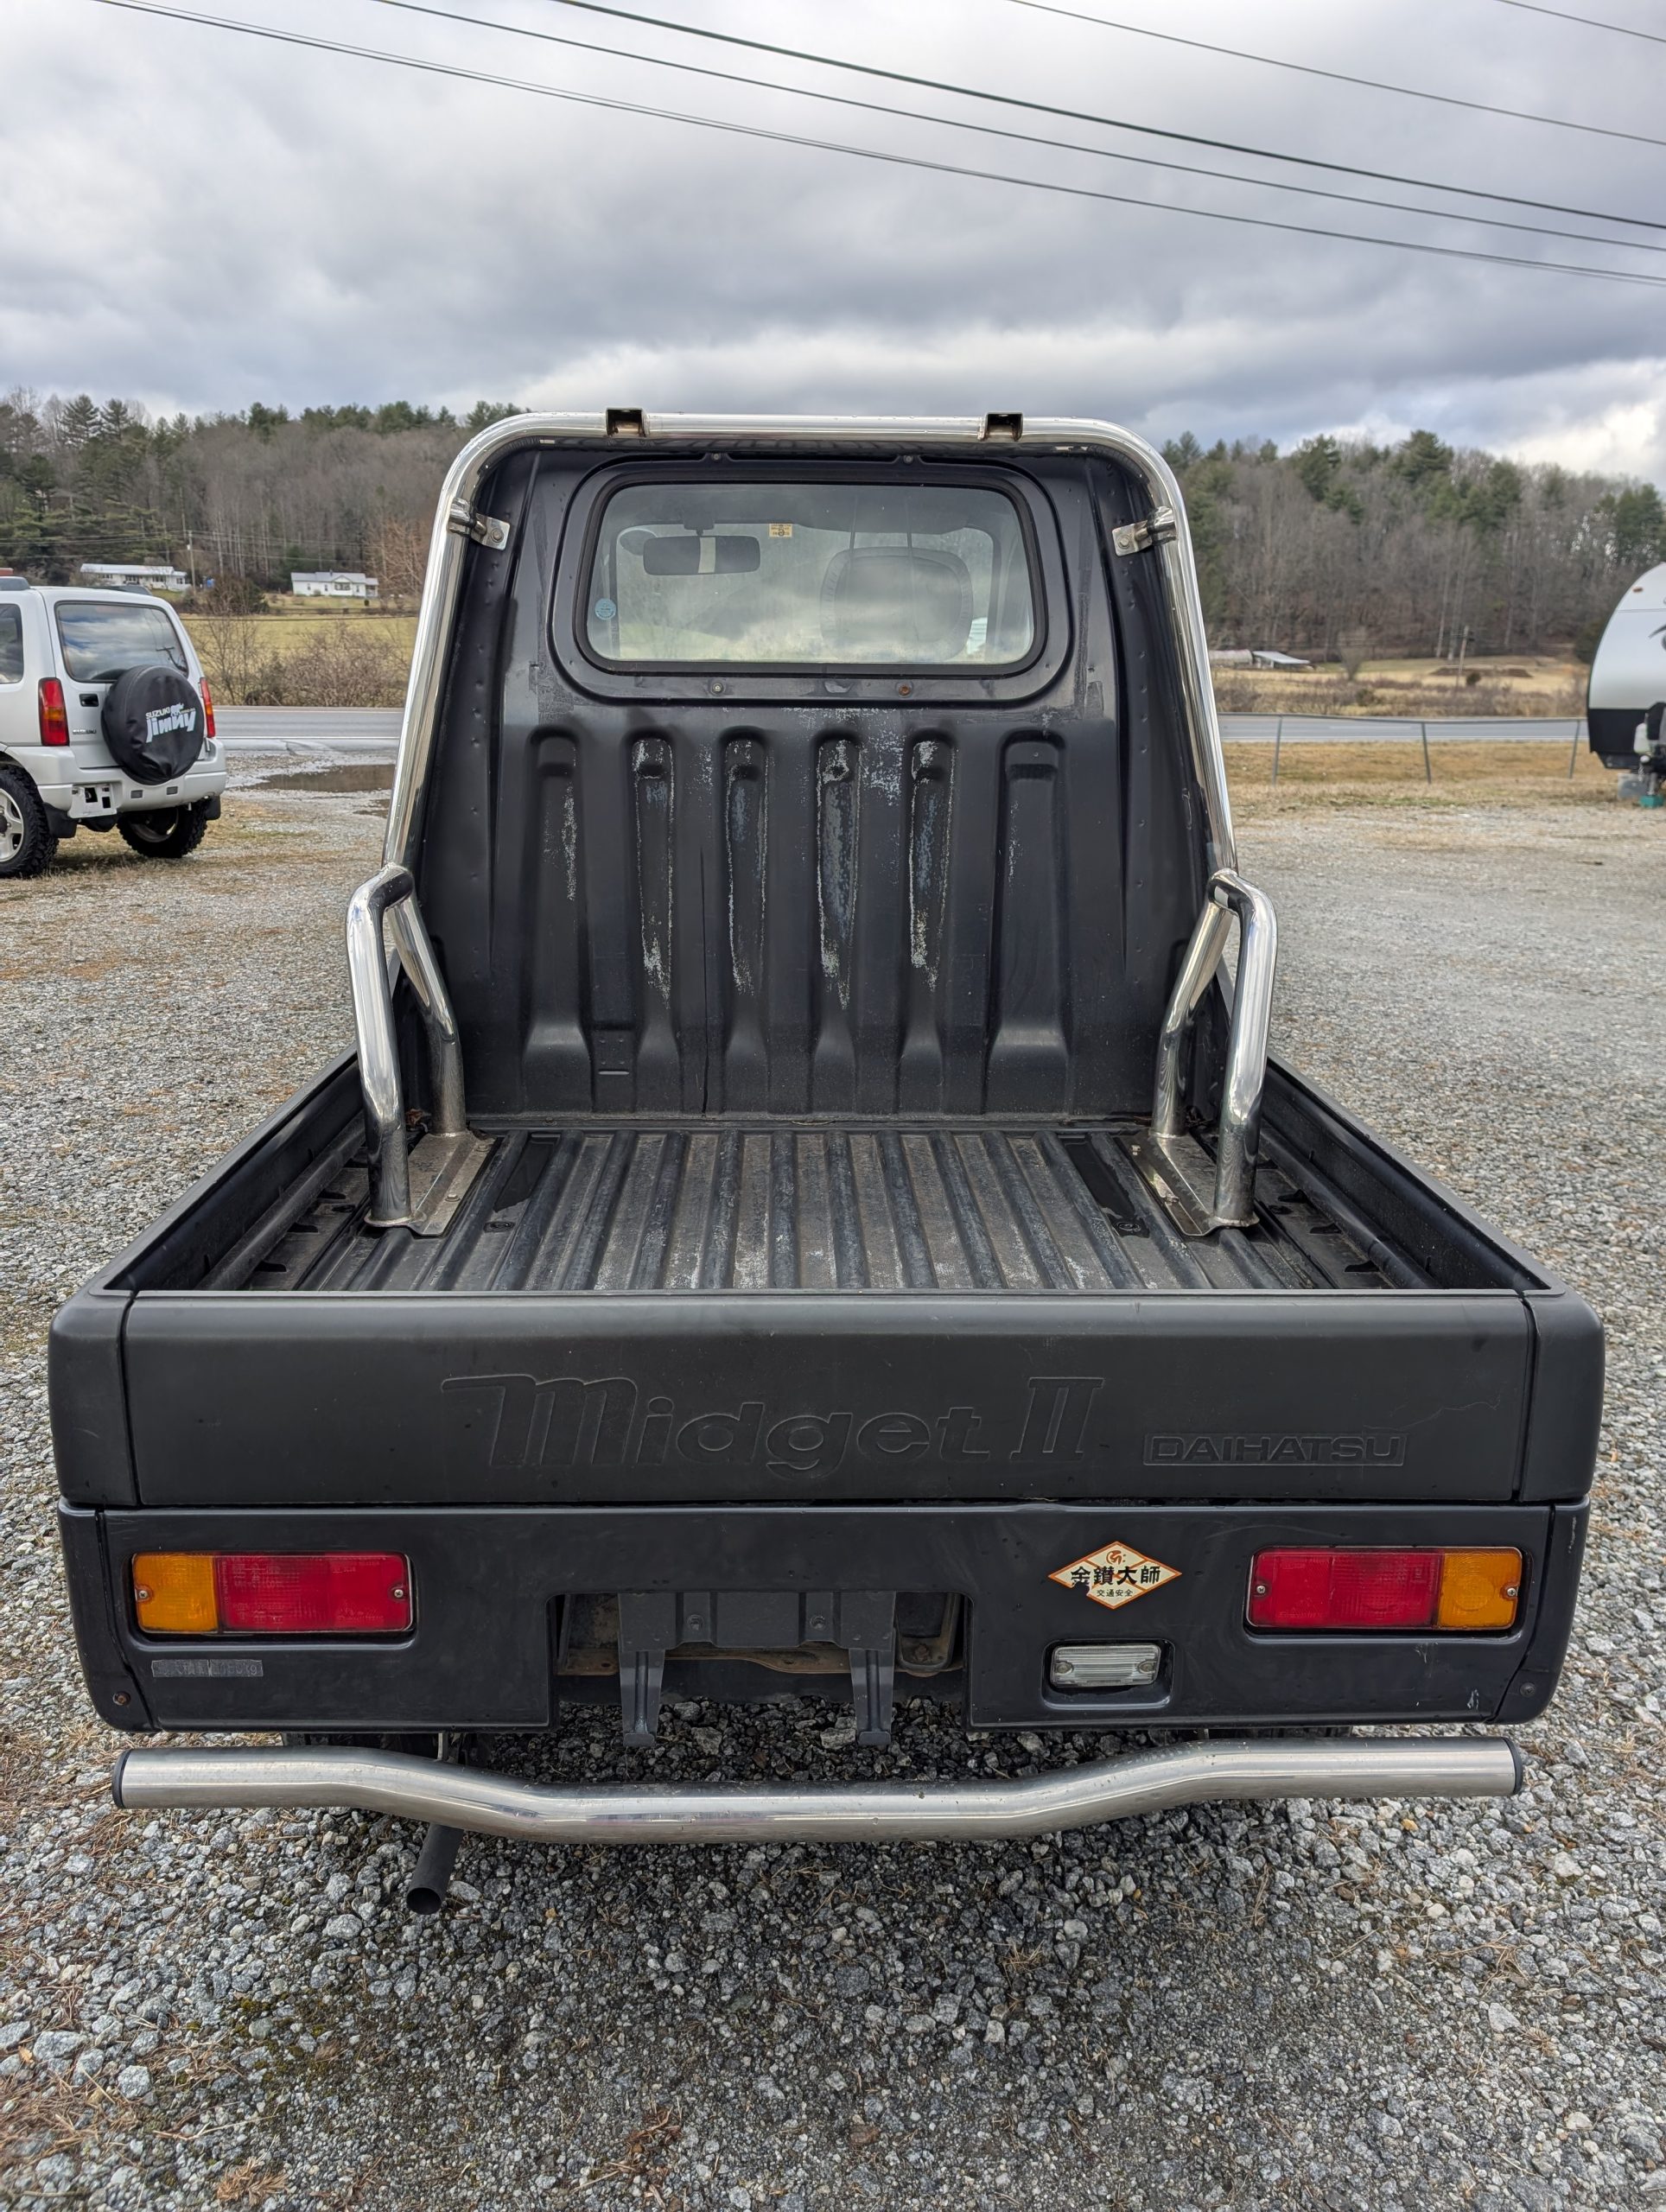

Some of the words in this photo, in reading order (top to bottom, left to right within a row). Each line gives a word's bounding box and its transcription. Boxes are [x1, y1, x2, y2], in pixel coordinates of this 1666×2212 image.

[145, 707, 171, 719] SUZUKI
[442, 1374, 990, 1479] Midget
[1152, 1437, 1401, 1461] DAIHATSU
[1097, 1589, 1133, 1598] 交通安全
